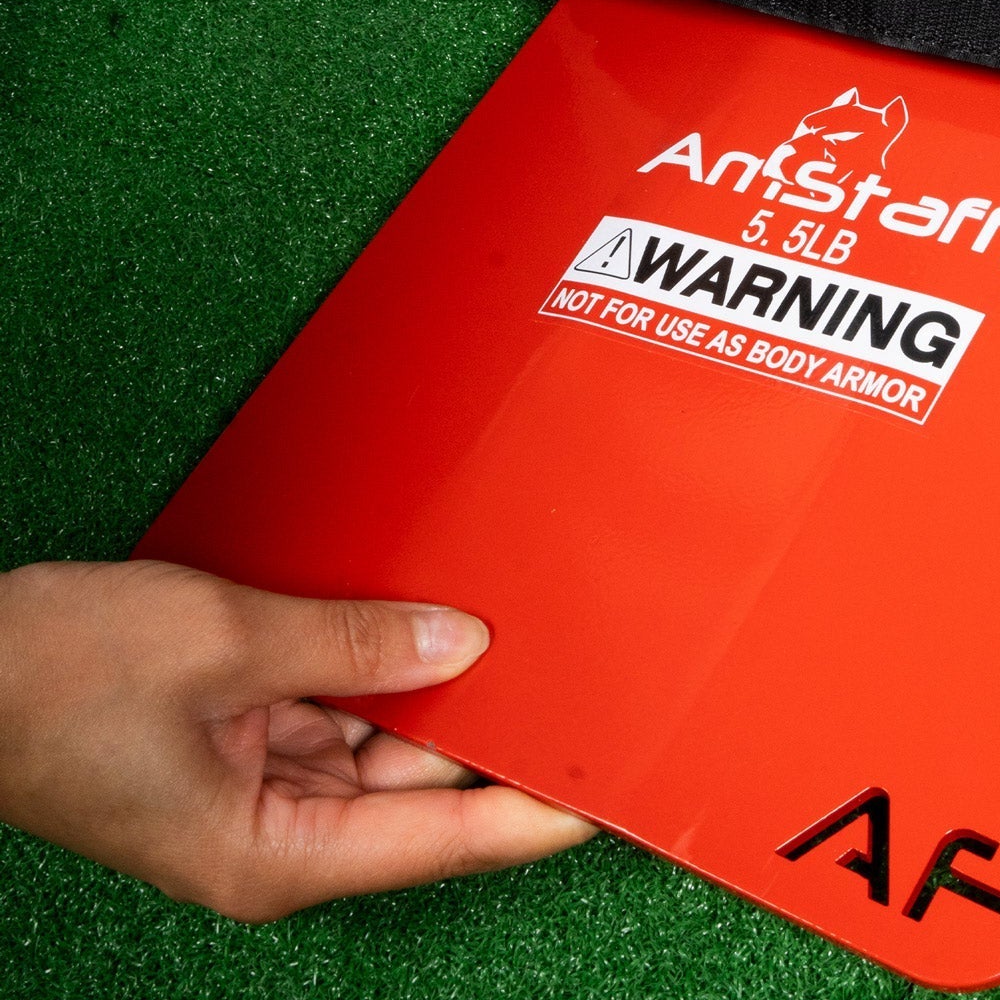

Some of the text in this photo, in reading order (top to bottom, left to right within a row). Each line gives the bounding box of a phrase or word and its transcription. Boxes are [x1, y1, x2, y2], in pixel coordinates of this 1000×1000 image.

[552, 287, 927, 413] NOT FOR USE AS BODY ARMOR
[633, 237, 962, 370] WARNING
